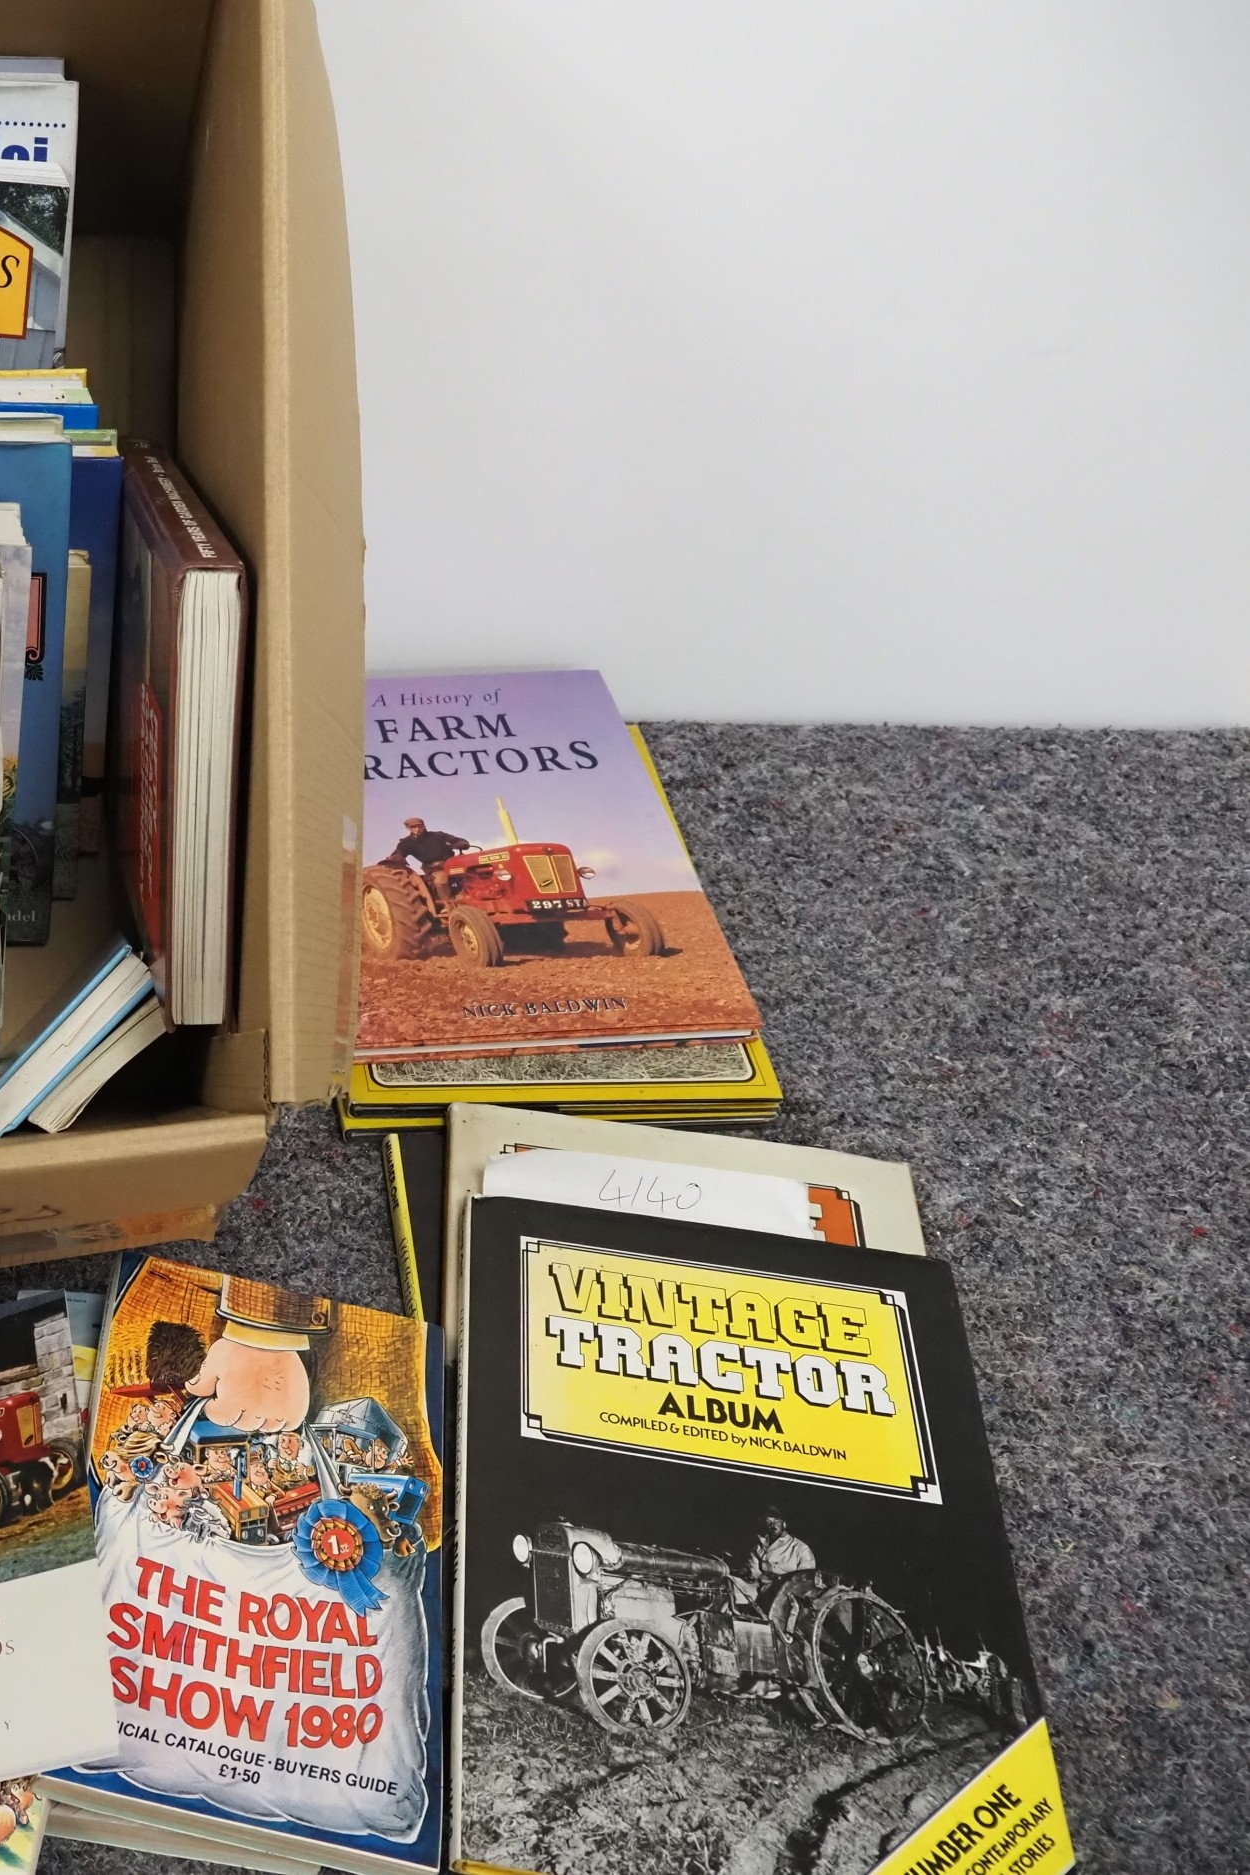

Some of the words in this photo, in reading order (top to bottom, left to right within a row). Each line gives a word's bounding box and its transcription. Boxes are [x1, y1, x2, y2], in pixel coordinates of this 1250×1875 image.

[372, 694, 386, 707] A
[400, 690, 472, 708] History
[483, 688, 502, 704] of
[374, 713, 517, 744] FARM
[363, 740, 600, 780] RACTORS
[532, 900, 562, 909] 297
[462, 1004, 518, 1020] NICK
[524, 998, 628, 1016] BALDWIN
[549, 1262, 871, 1356] VINTAGE
[546, 1314, 896, 1416] TRACTOR
[599, 1411, 668, 1433] COMPILED
[670, 1422, 680, 1434] &
[682, 1424, 729, 1442] EDITED
[731, 1432, 748, 1448] by
[749, 1436, 782, 1450] NICK
[783, 1441, 848, 1460] BALDWIN
[657, 1391, 785, 1434] ALBUM
[136, 1556, 226, 1626] THE
[238, 1591, 378, 1647] ROYAL
[106, 1602, 383, 1700] SMITHFIELD
[110, 1655, 275, 1742] SHOW
[284, 1702, 383, 1749] 1980
[117, 1720, 160, 1744] ICIAL
[164, 1733, 266, 1768] CATALOGUE
[274, 1758, 342, 1784] BUYERS
[345, 1774, 399, 1796] GUIDE
[974, 1784, 1022, 1830] ONE
[1008, 1834, 1056, 1875] STORIES
